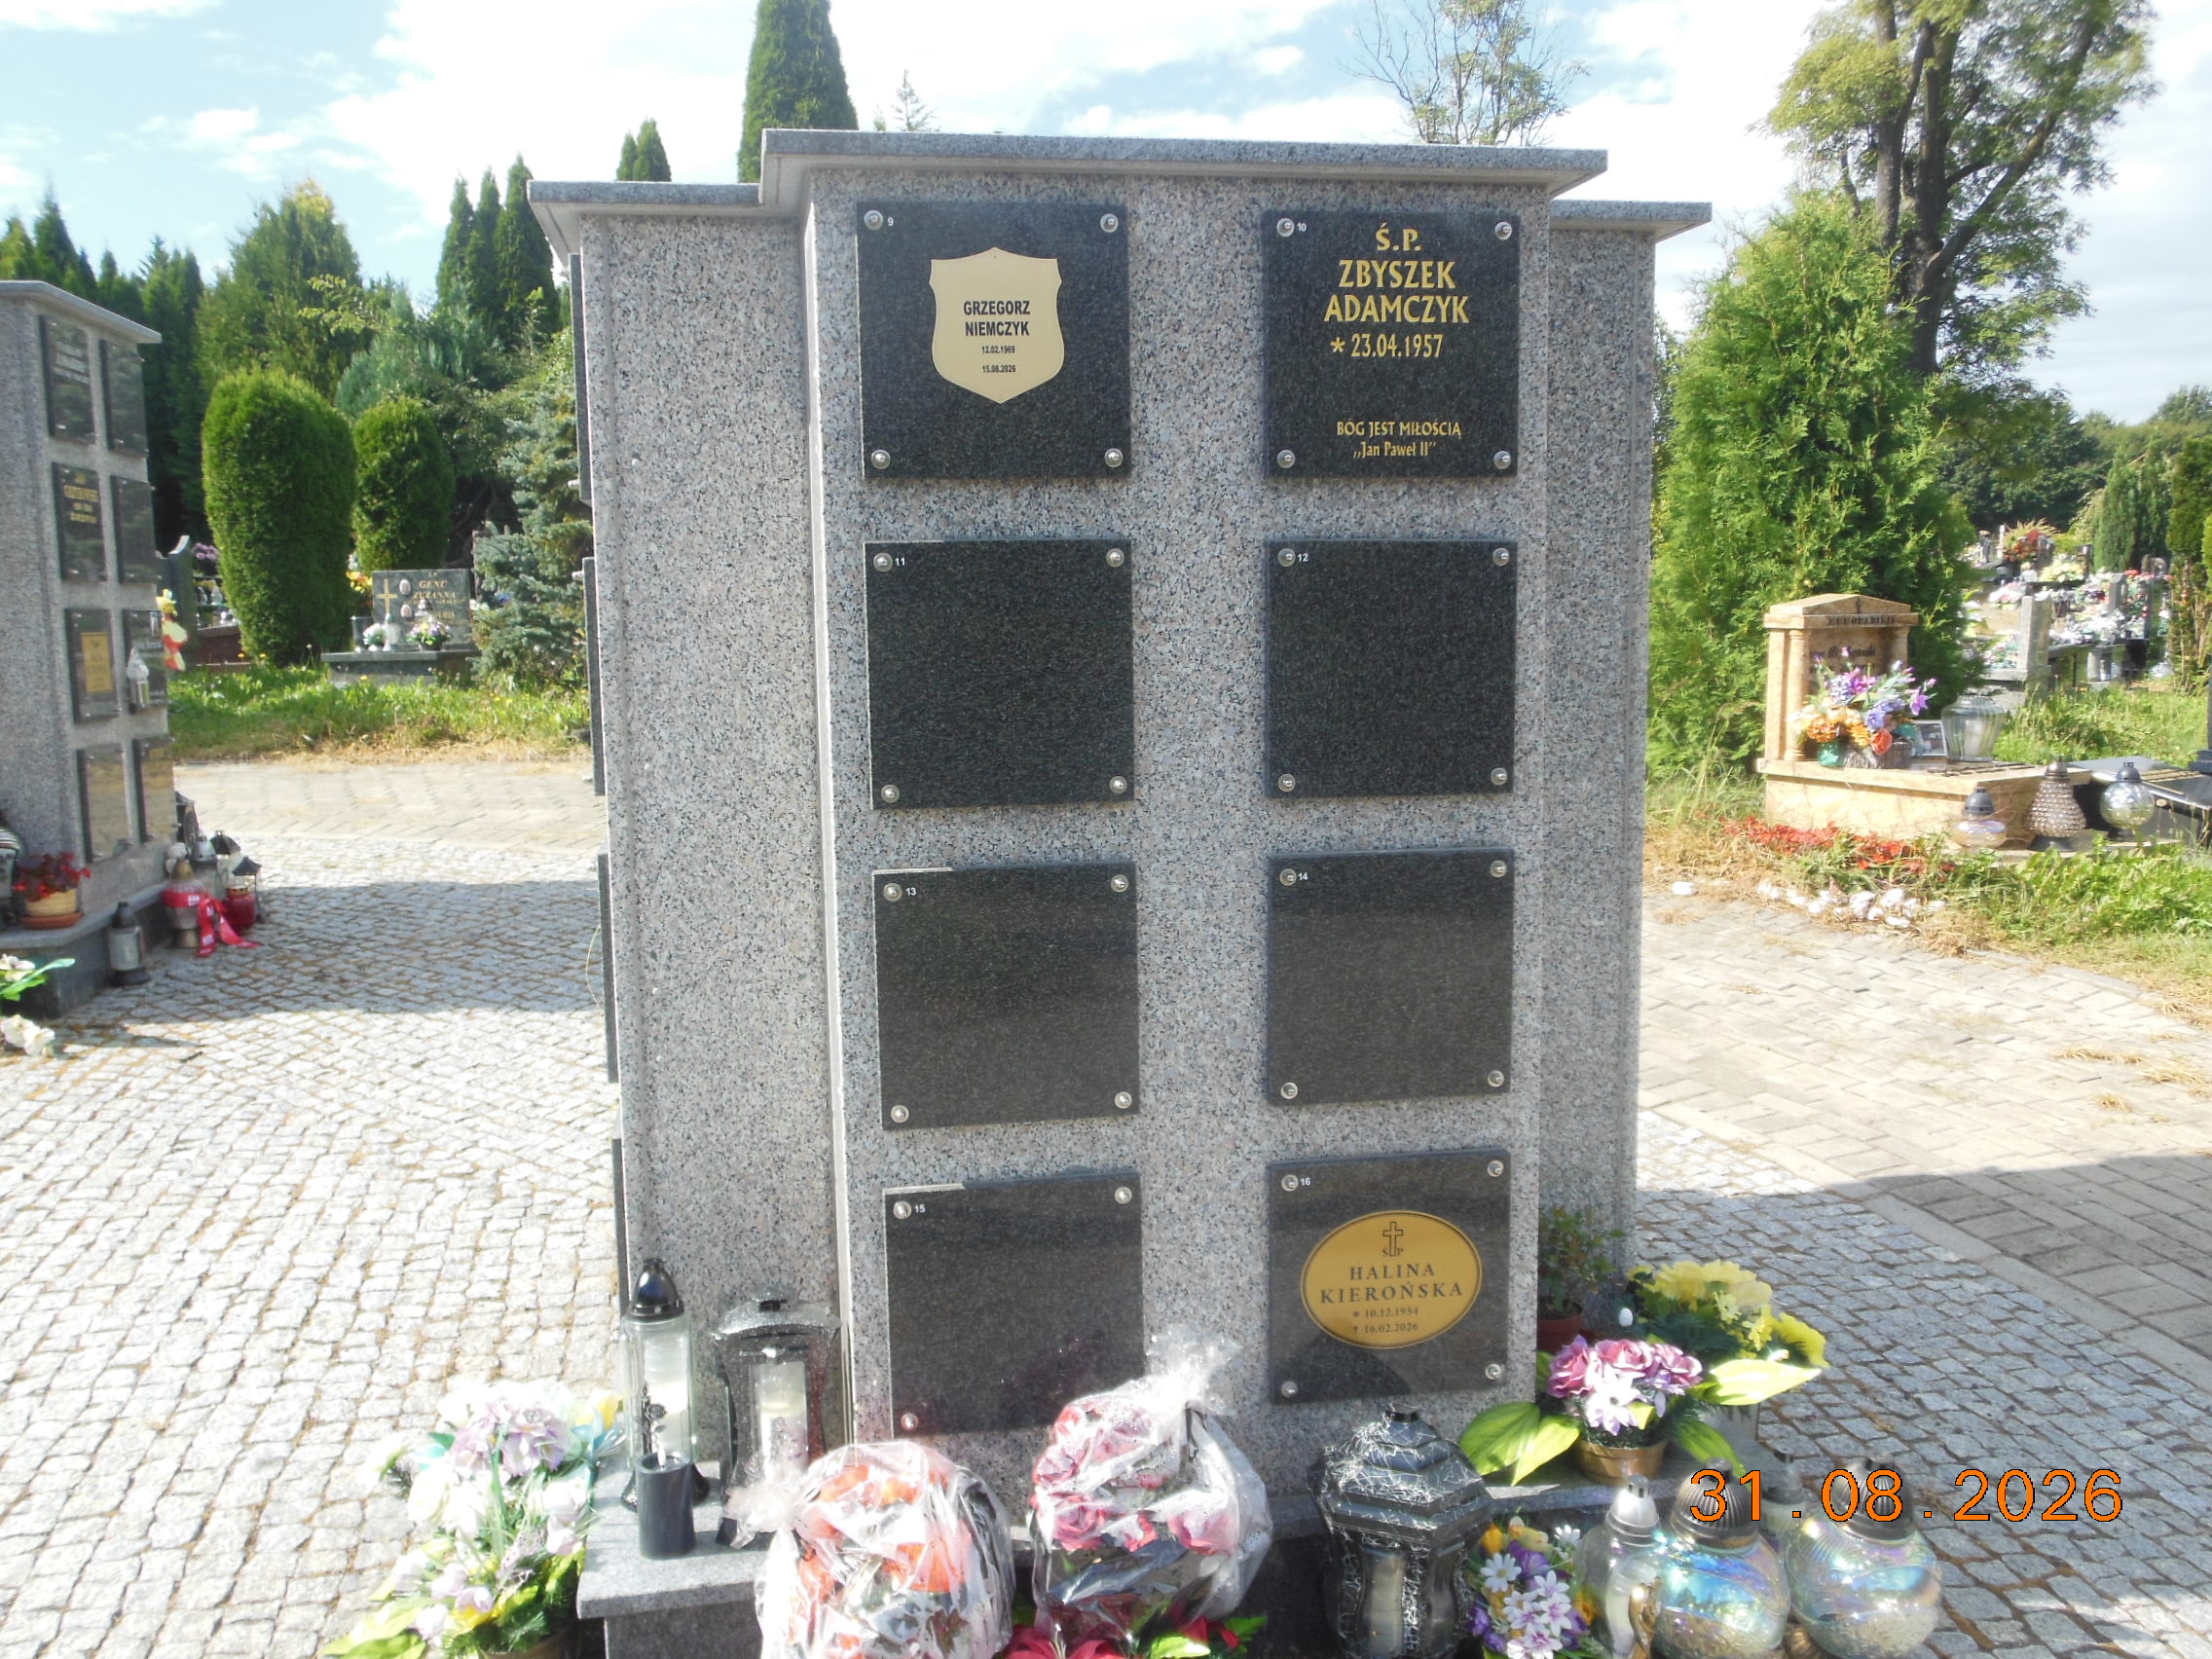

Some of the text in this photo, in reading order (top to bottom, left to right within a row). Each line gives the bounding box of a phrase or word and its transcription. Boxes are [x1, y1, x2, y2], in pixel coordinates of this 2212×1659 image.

[887, 217, 894, 227] 9
[1297, 222, 1307, 232] 10
[1375, 222, 1422, 251] Ś.P.
[1338, 258, 1456, 289] ZBYSZEK
[963, 300, 1031, 315] GRZEGORZ
[1323, 294, 1470, 323] ADAMCZYK
[965, 320, 1030, 337] NIEMCZYK
[1350, 333, 1444, 358] 23.04.1957
[1336, 419, 1462, 439] BÓG JEST MIŁOŚCIĄ
[1383, 441, 1417, 457] Paweł
[895, 558, 905, 567] 11
[1297, 552, 1309, 563] 12
[1298, 871, 1309, 881] 14
[905, 887, 916, 896] 13
[1300, 1177, 1310, 1186] 16
[914, 1204, 925, 1213] 15
[1349, 1263, 1436, 1280] HALINA
[1320, 1281, 1463, 1305] KIEROŃSKA
[1364, 1306, 1419, 1318] 10.12.1954
[1364, 1322, 1419, 1334] 16.02.2026
